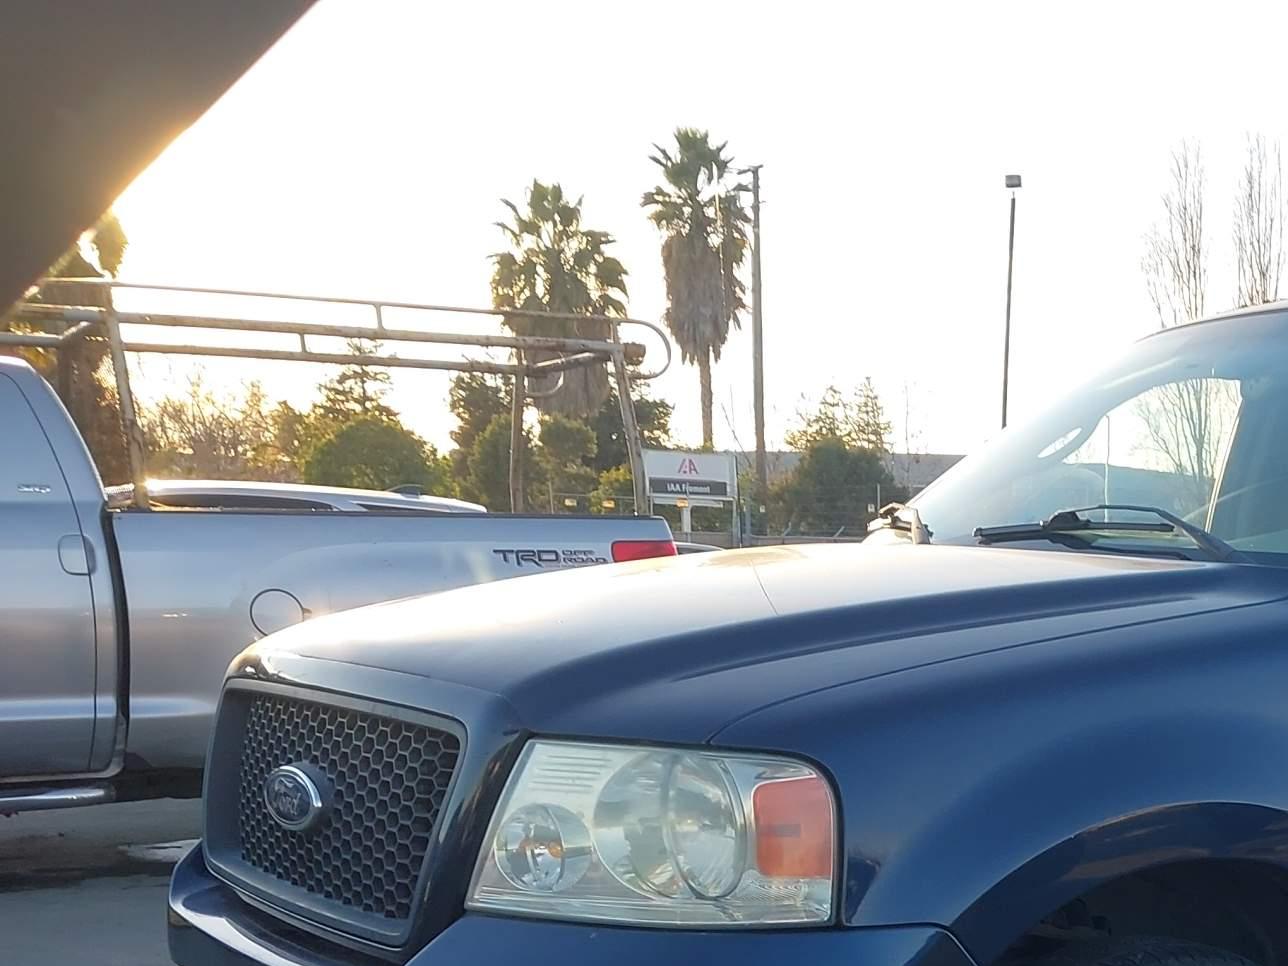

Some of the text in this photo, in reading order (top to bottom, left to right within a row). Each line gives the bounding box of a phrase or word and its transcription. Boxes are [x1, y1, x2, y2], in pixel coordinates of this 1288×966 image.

[562, 549, 595, 557] OFF
[493, 549, 561, 568] TRD
[562, 556, 608, 564] ROAD
